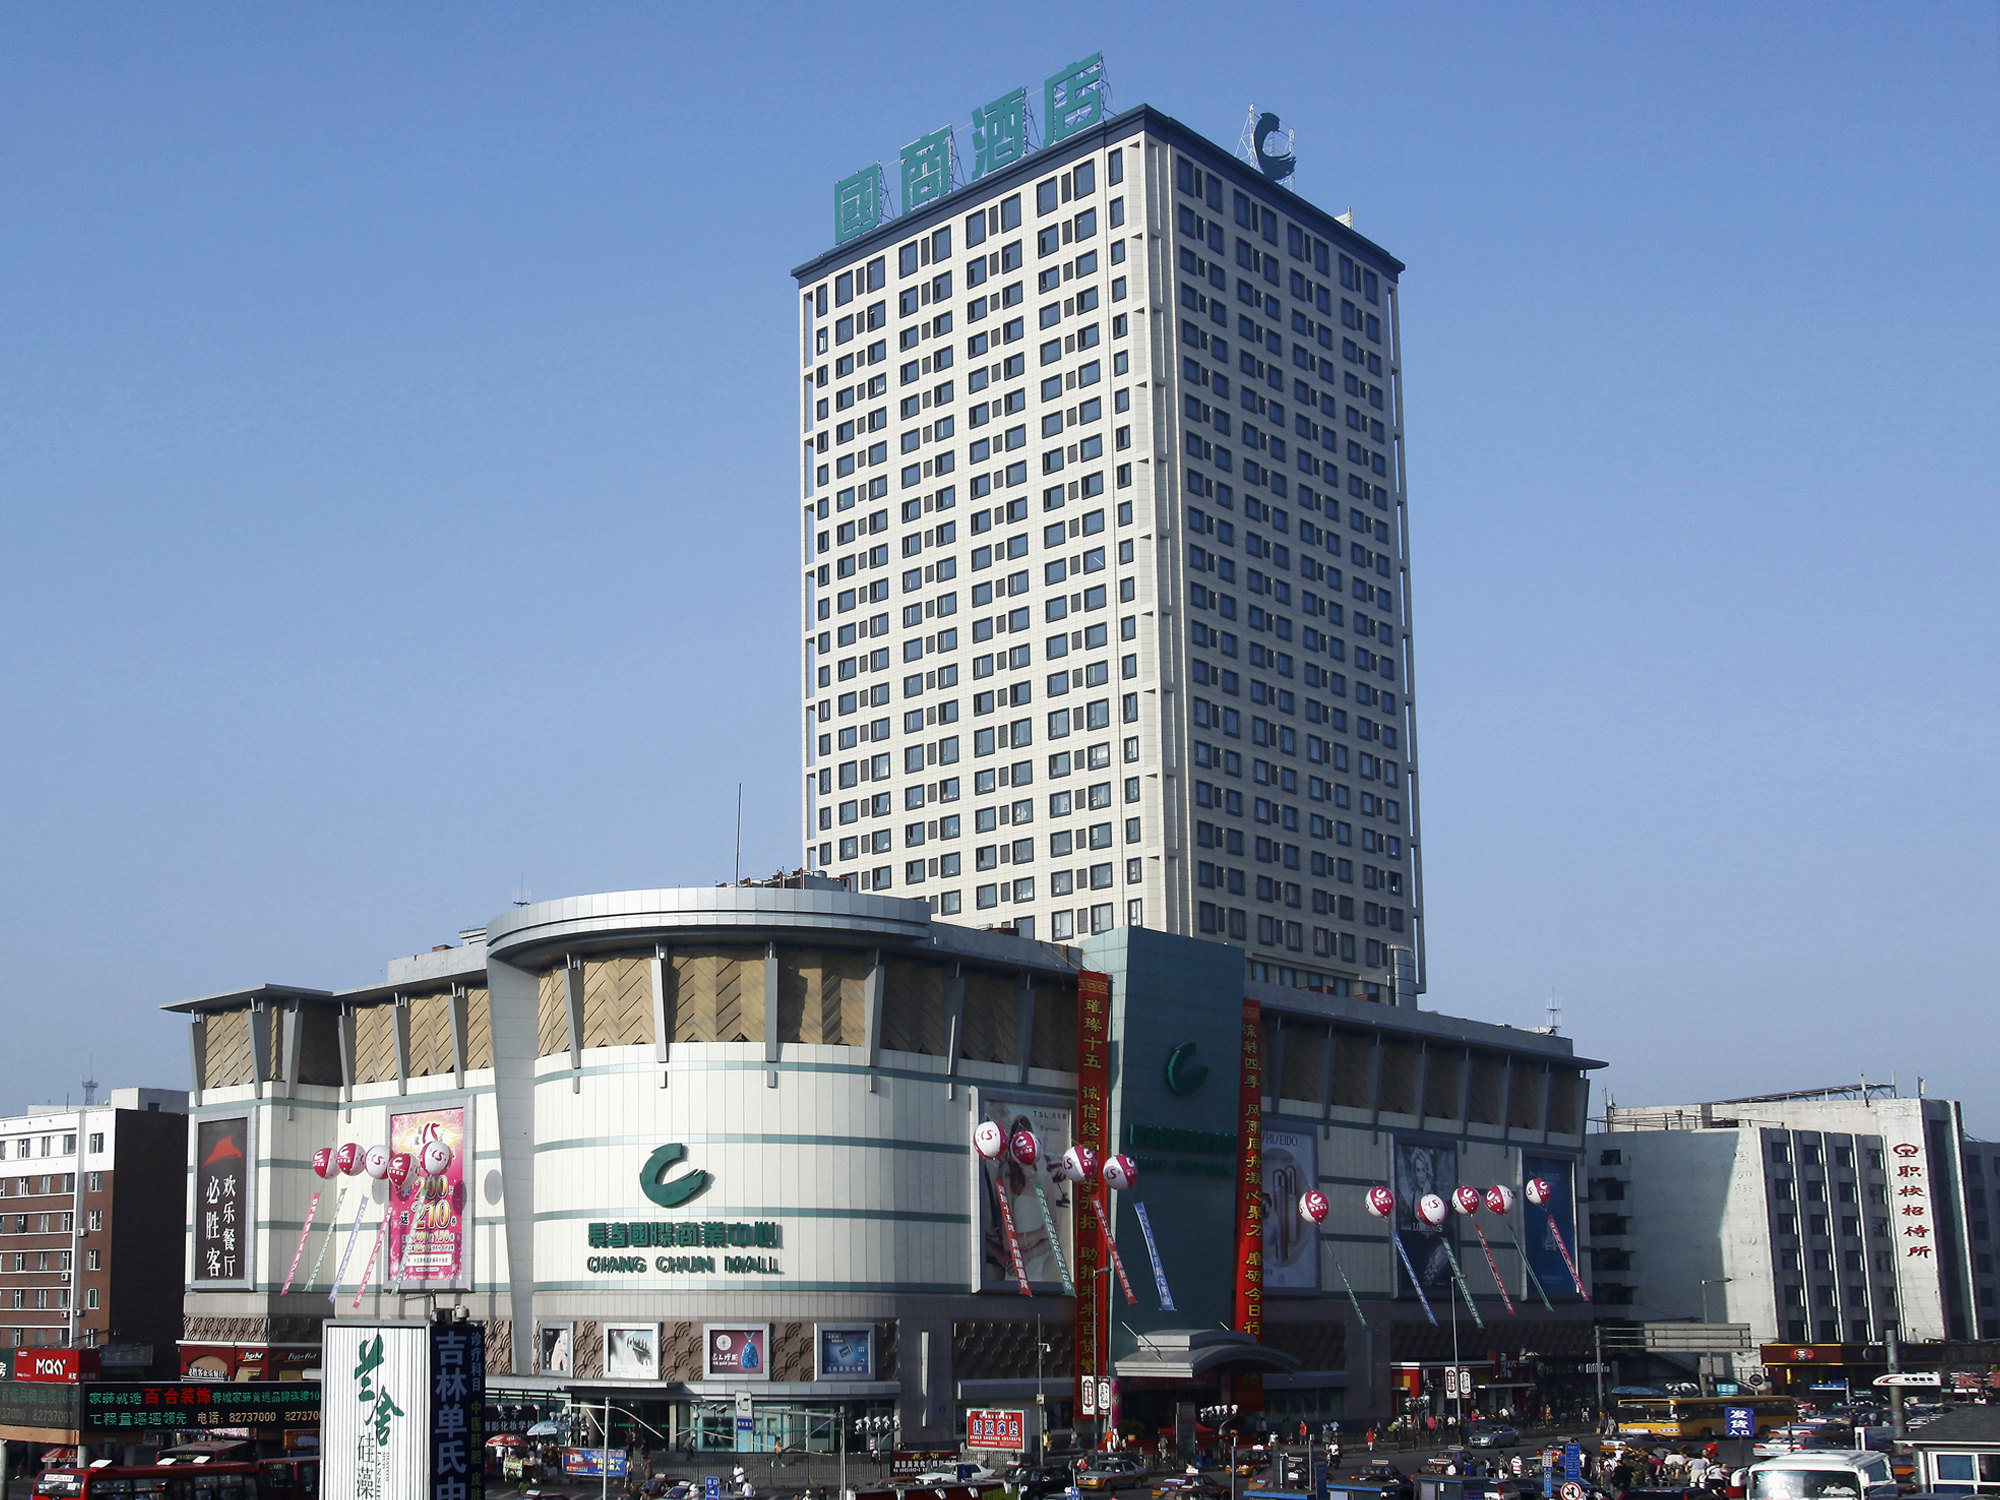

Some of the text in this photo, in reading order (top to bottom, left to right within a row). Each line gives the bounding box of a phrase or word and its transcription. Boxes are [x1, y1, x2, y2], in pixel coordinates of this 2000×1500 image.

[1083, 998, 1102, 1069] 璀璨十五
[206, 1176, 222, 1277] 必胜客
[222, 1174, 236, 1277] 欢乐餐厅
[1897, 1165, 1932, 1259] 职校招待所
[588, 1221, 777, 1249] 長春國際商業中心
[587, 1256, 781, 1274] CHANG CHUN MALL
[470, 1332, 482, 1392] 诊疗科目
[229, 1411, 276, 1423] 82737000
[1729, 1409, 1748, 1429] 发货
